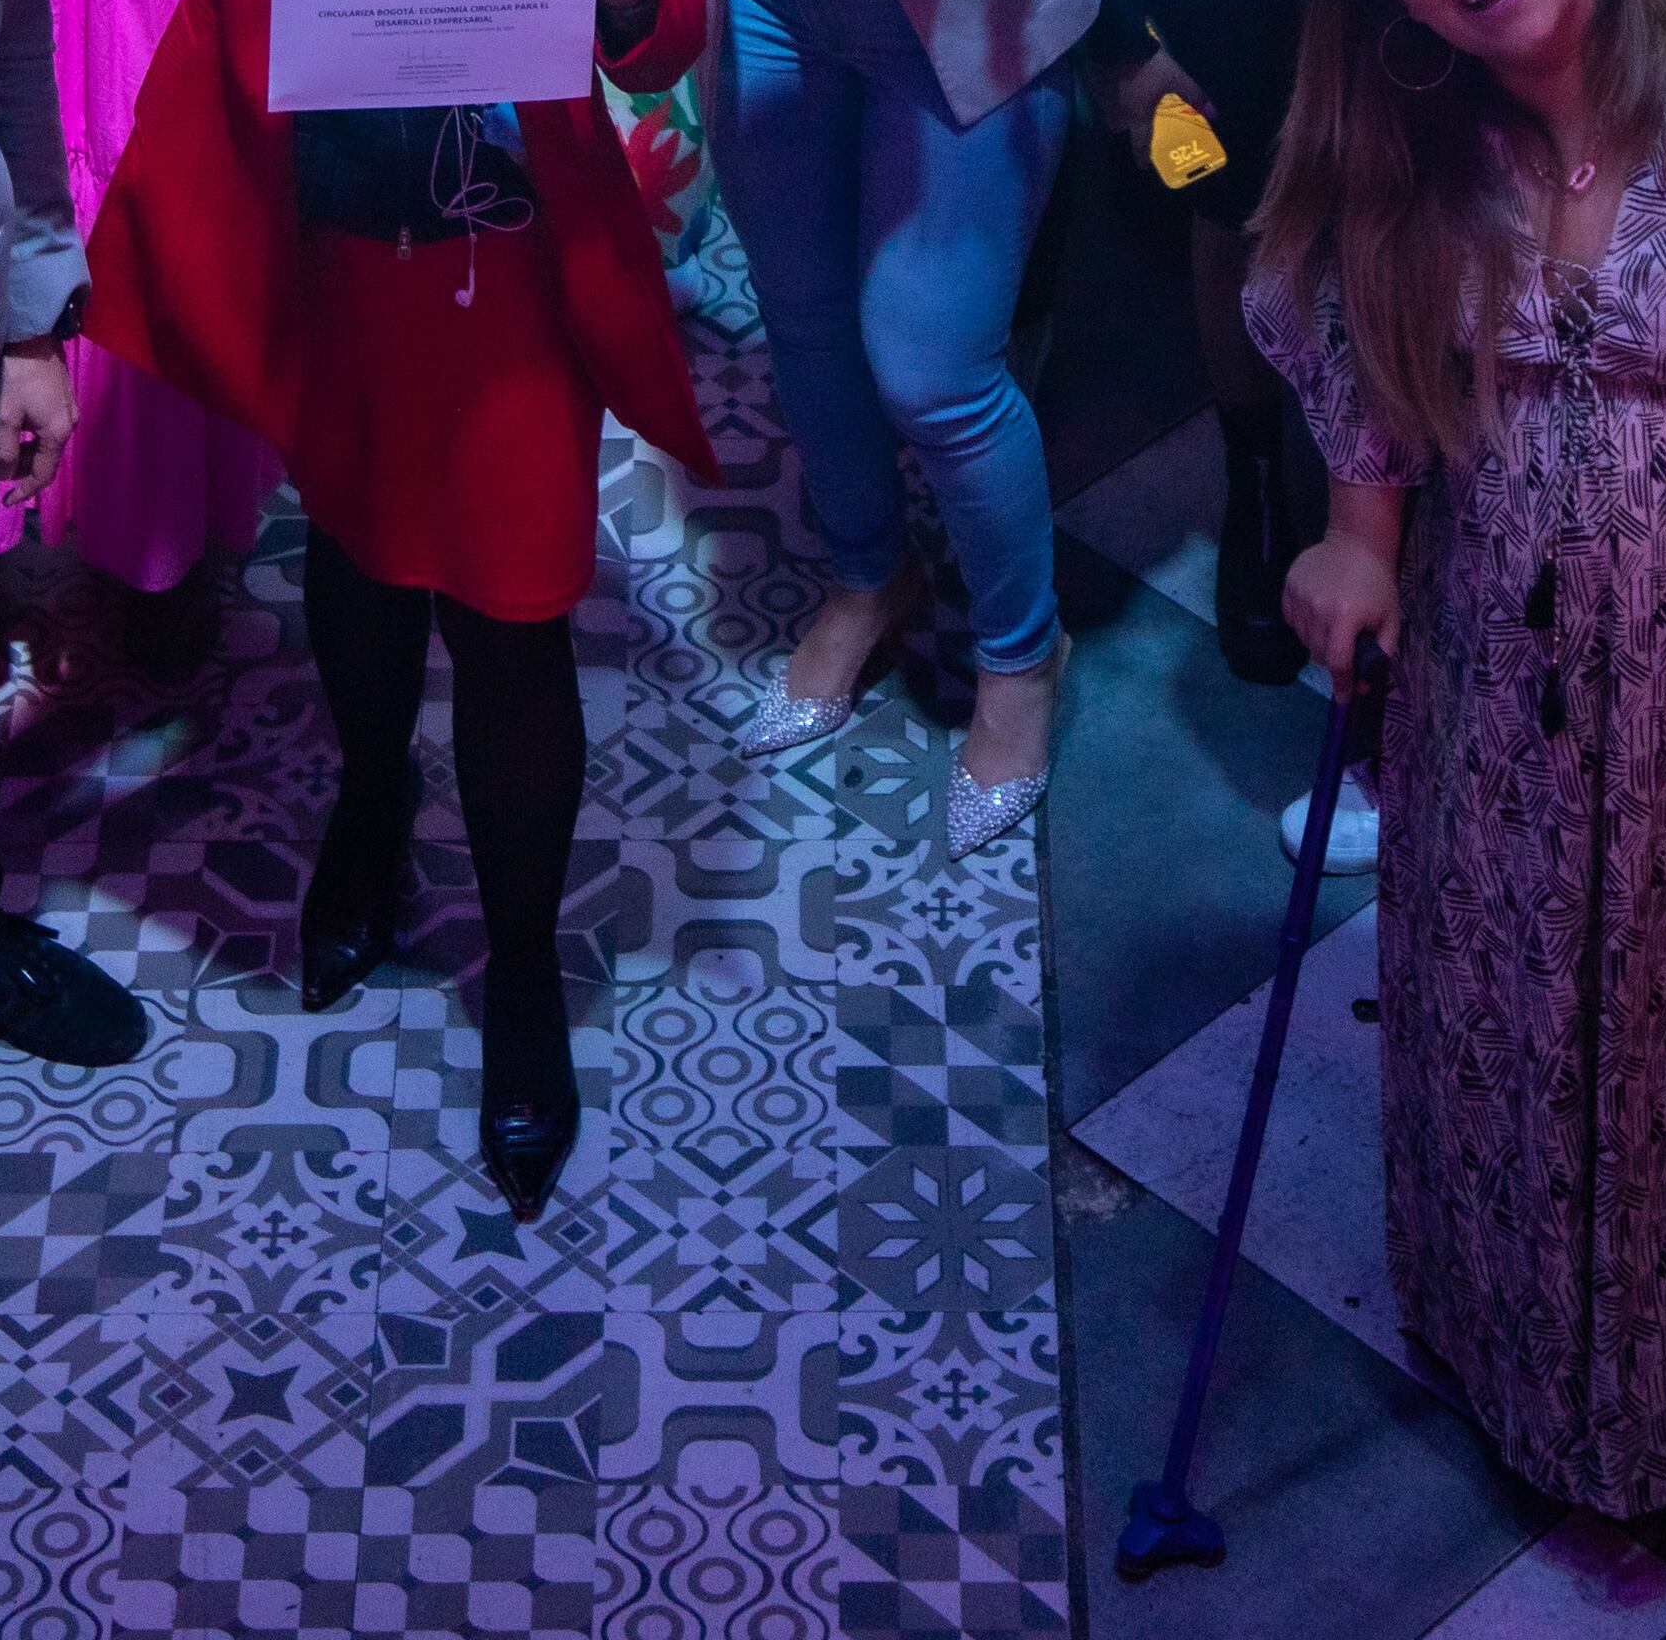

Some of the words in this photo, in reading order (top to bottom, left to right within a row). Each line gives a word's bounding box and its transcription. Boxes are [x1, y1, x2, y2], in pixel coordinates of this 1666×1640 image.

[318, 8, 375, 19] CIRCULARIZA
[376, 5, 416, 16] BOGOTÁ:
[419, 3, 468, 15] ECONOMÍA
[470, 3, 512, 13] CIRCULAR
[514, 2, 539, 11] PARA
[541, 1, 549, 10] EL
[375, 17, 431, 28] DESARROLLO
[433, 15, 493, 25] EMPRESARIAL
[1170, 140, 1204, 165] 7:25
